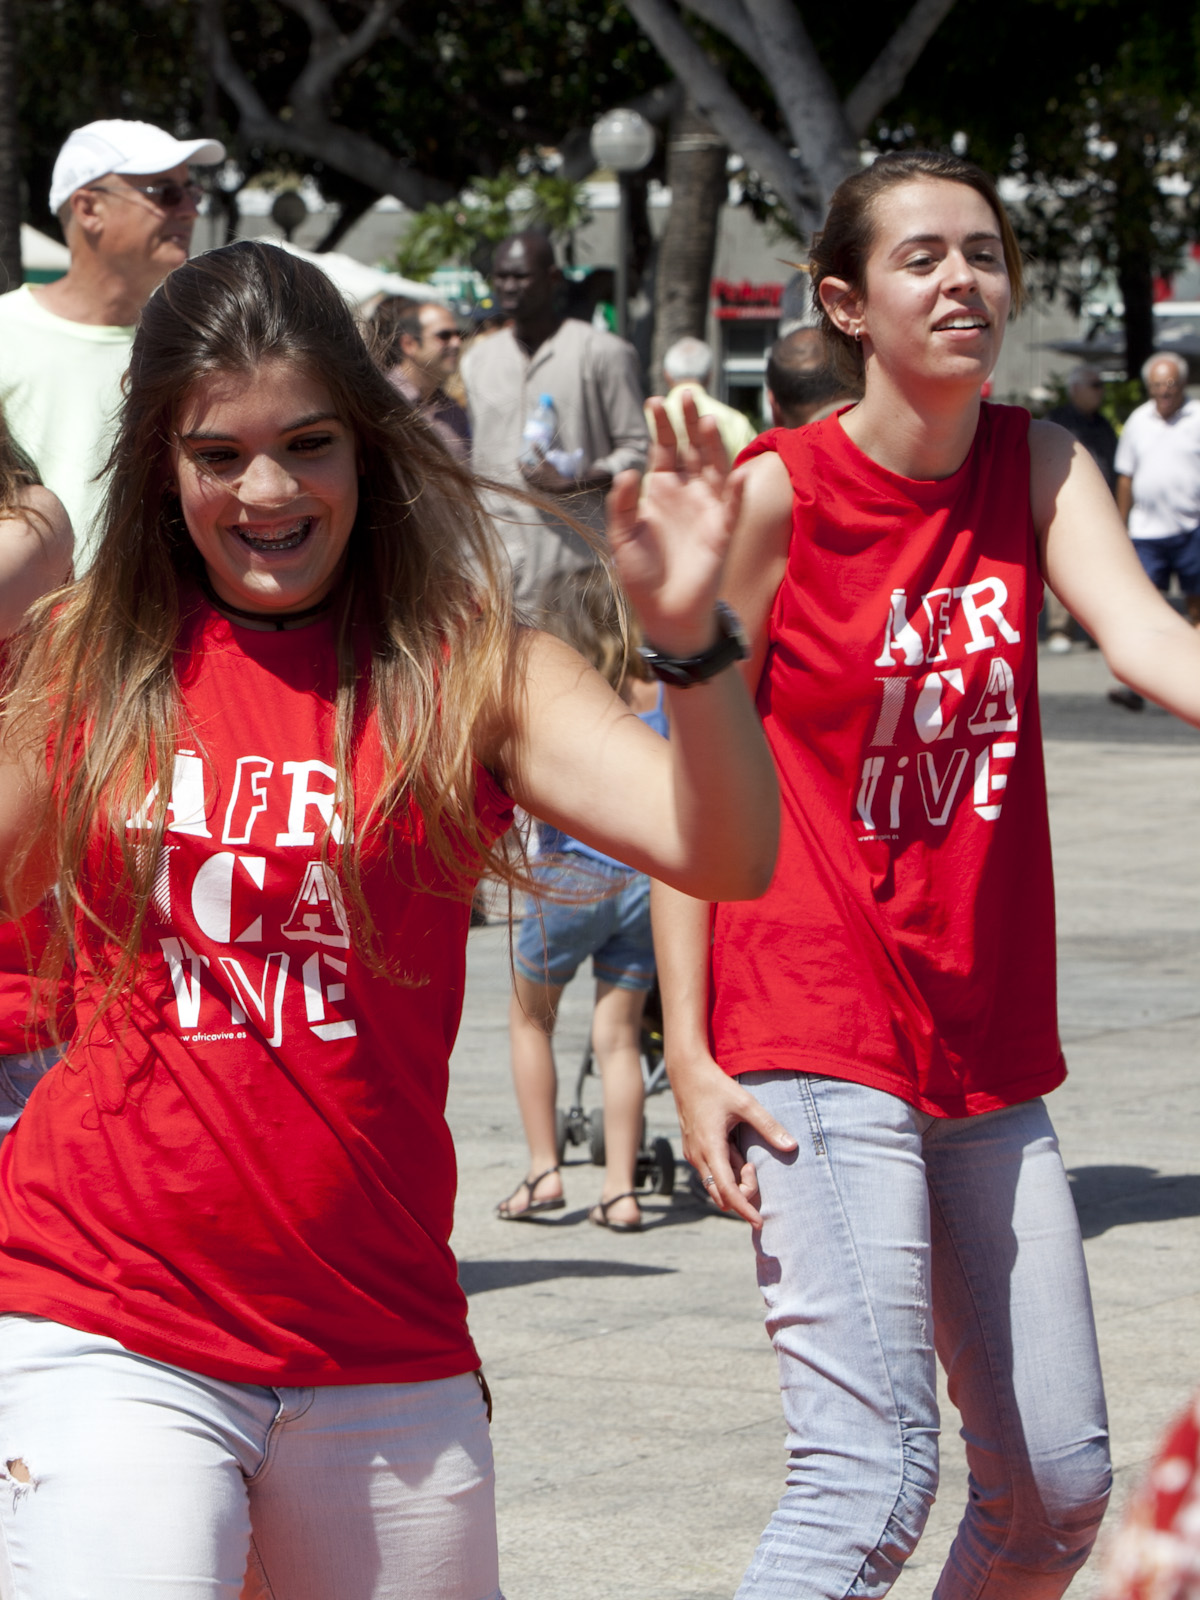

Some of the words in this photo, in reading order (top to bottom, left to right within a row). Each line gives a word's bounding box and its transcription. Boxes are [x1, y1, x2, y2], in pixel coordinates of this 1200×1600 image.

[875, 577, 1020, 666] AFR
[868, 657, 1018, 747] ICA
[126, 749, 355, 847] AFR
[128, 845, 350, 949] ICA
